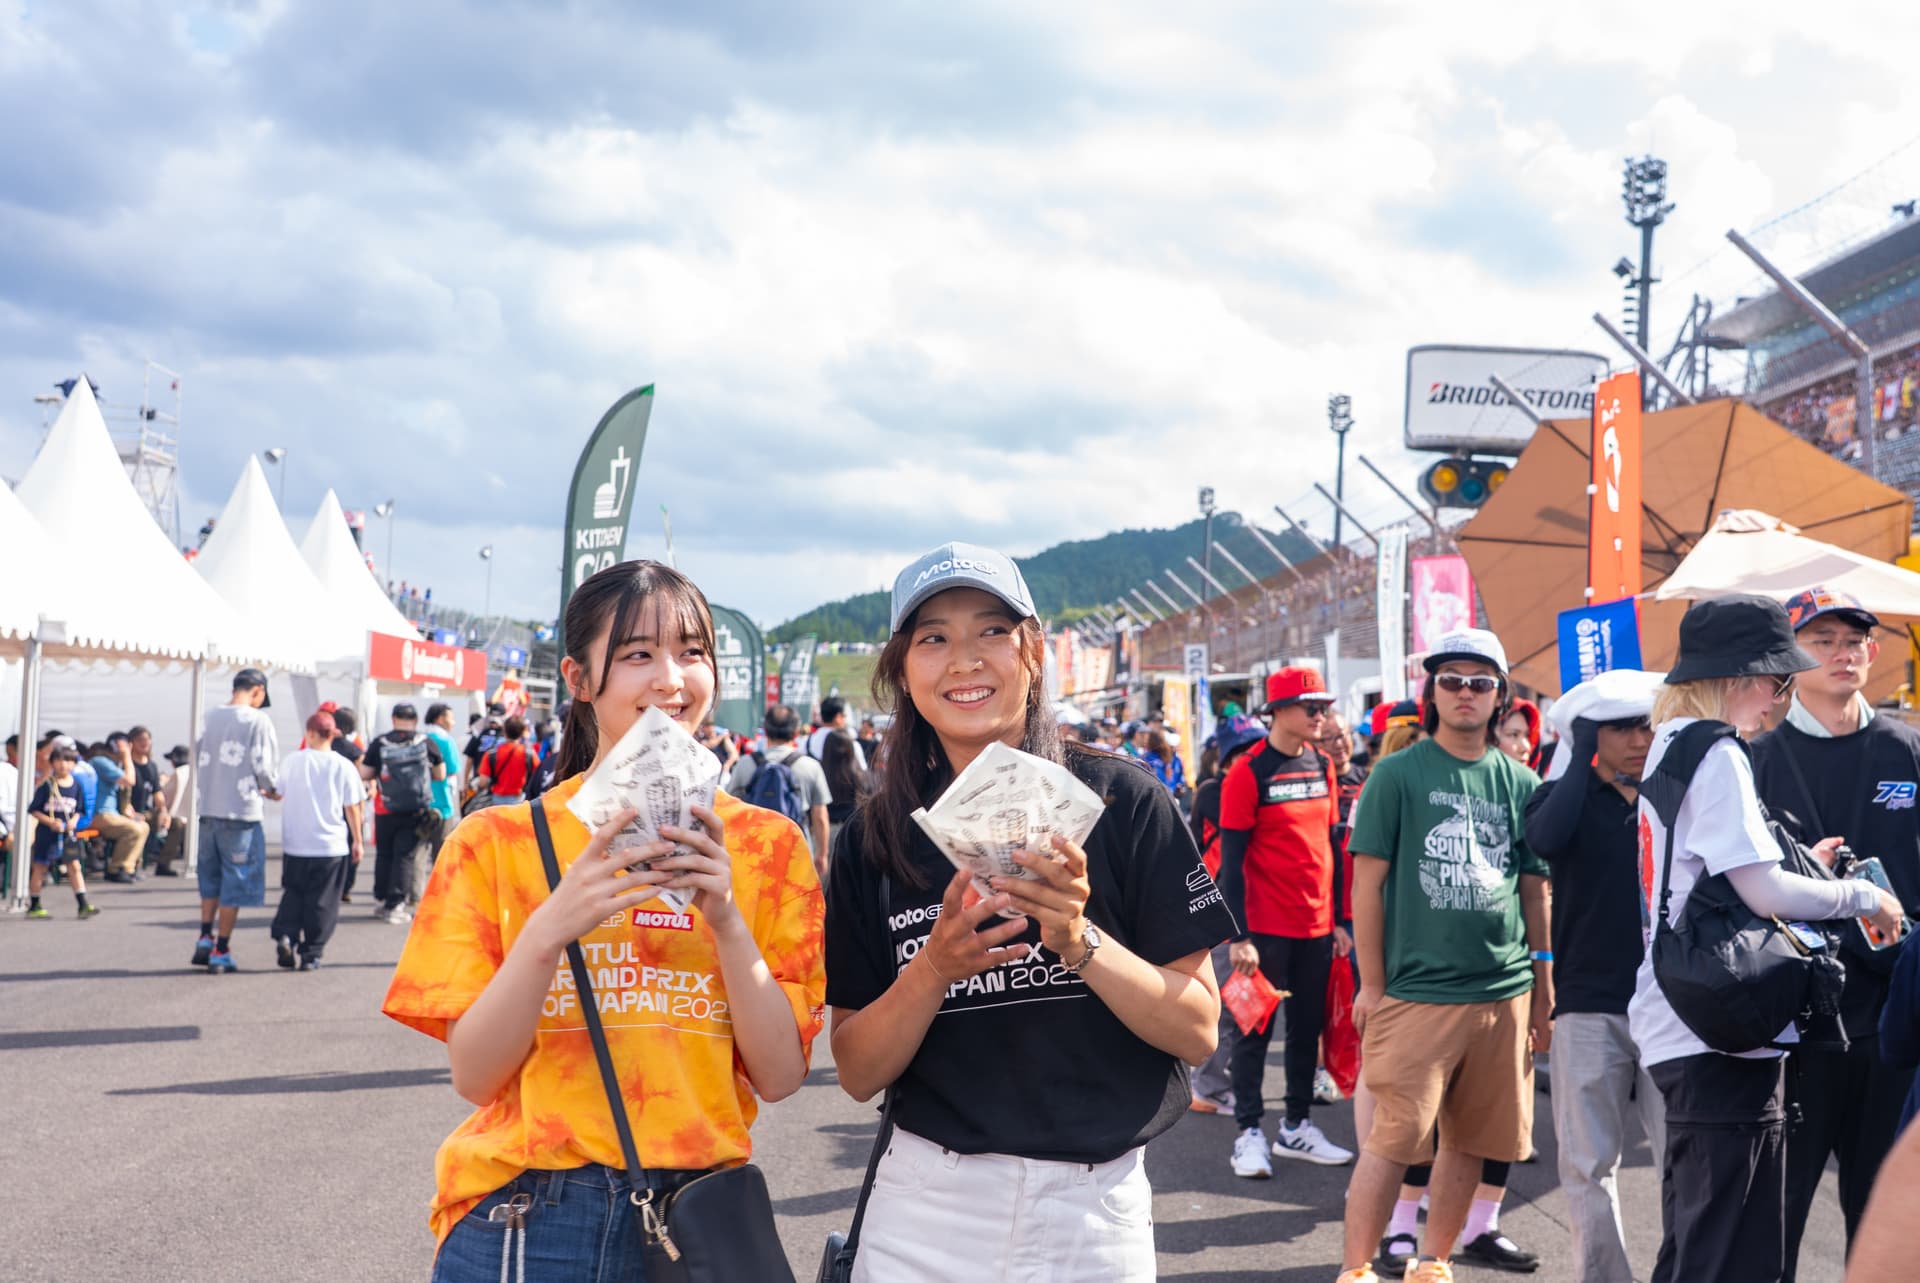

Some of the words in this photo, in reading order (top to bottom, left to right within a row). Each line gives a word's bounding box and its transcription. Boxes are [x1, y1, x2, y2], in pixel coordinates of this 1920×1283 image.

[1427, 382, 1595, 411] BRIDGSTONE
[1872, 781, 1917, 803] 79
[1189, 891, 1223, 914] MOTEG
[634, 911, 692, 930] MOTUL
[641, 966, 714, 995] PRIX
[944, 971, 1006, 999] PAN
[1011, 963, 1085, 989] 202
[542, 993, 576, 1017] OF
[672, 996, 734, 1024] 202
